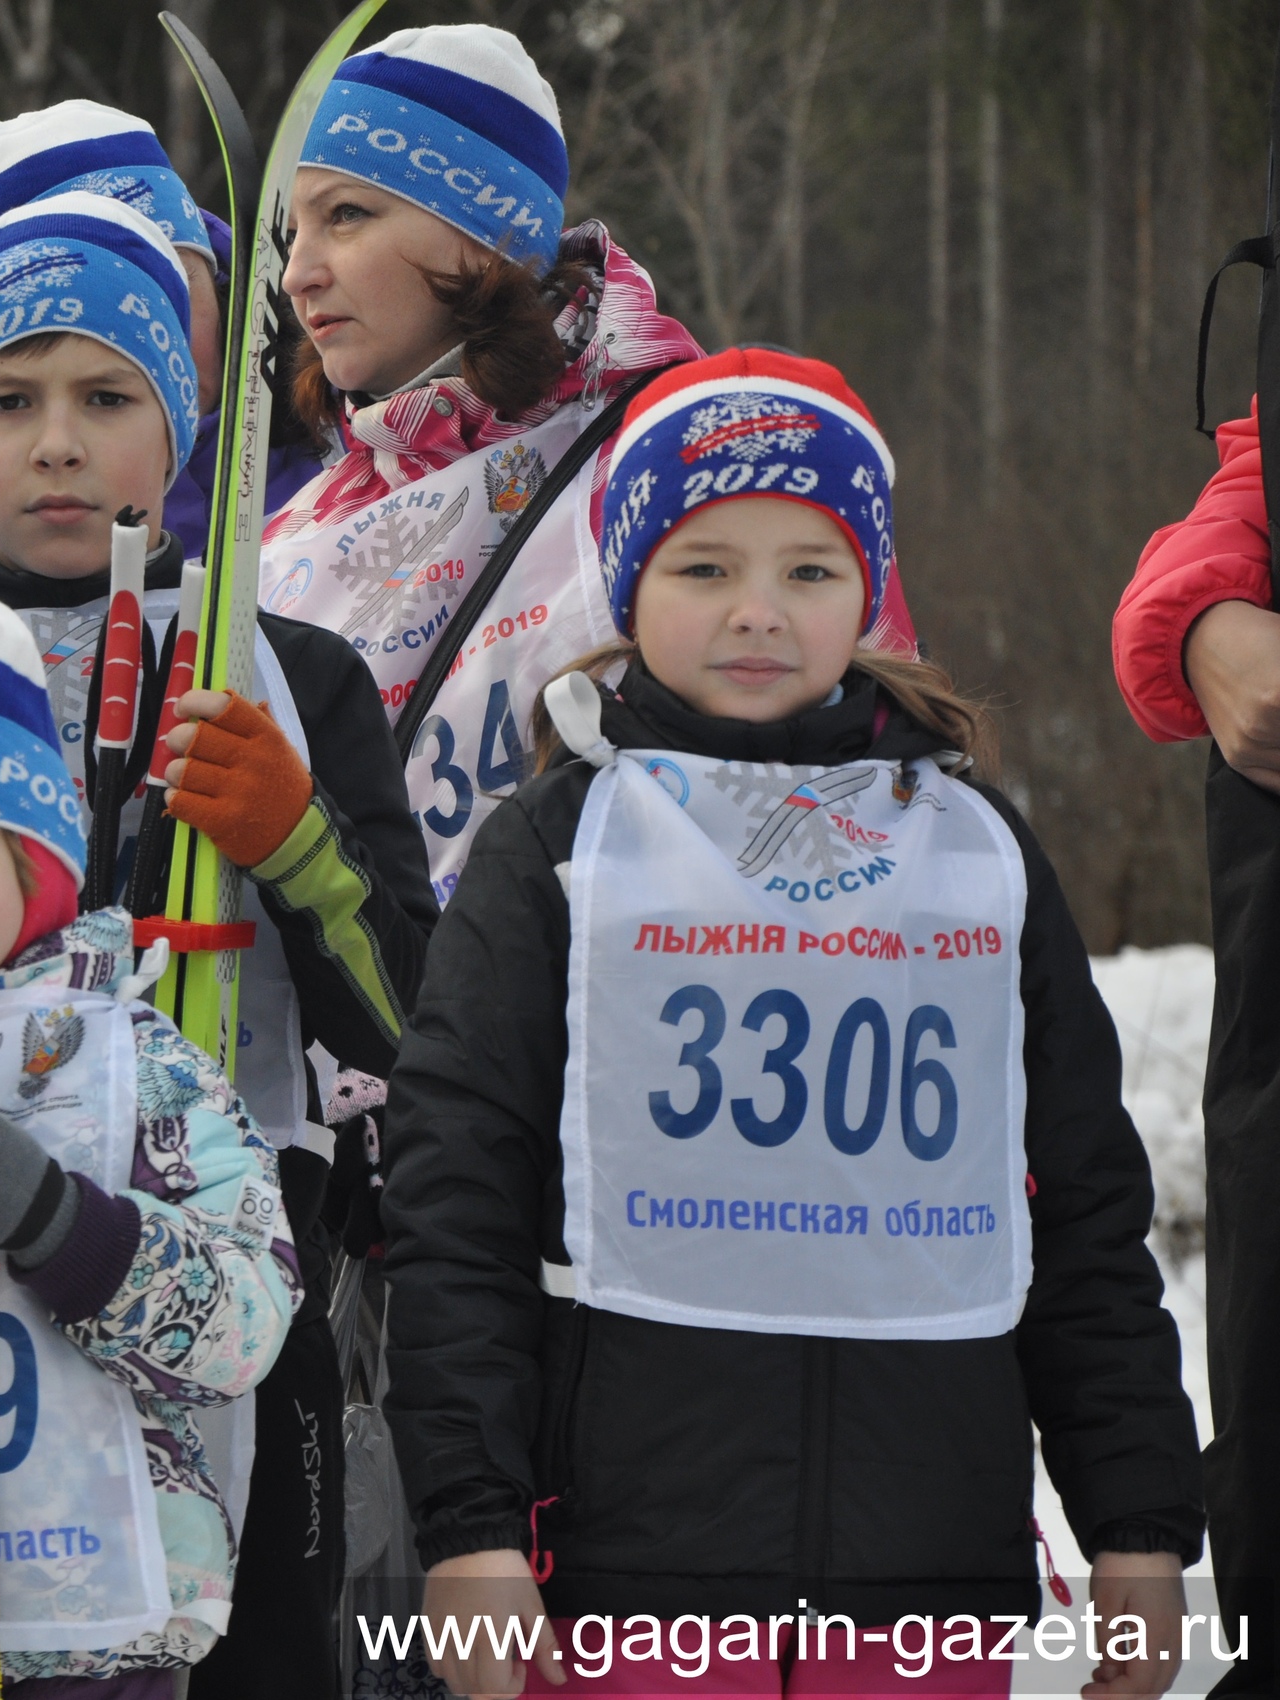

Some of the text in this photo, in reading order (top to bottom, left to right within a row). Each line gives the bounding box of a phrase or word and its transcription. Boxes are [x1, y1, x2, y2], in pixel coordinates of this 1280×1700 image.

[327, 113, 543, 237] РОССИИ
[683, 463, 819, 509] 2019
[336, 490, 446, 556] ЛЫЖНЯ
[412, 558, 465, 590] 2019
[351, 604, 450, 657] РОССИИ
[482, 604, 549, 648] 2019
[764, 856, 897, 903] РОССИИ
[634, 923, 786, 957] ЛЫЖНЯ
[798, 924, 907, 961] РОССИИ
[935, 926, 1002, 960] 2019
[648, 984, 959, 1162] 3306
[626, 1190, 996, 1237] Смоленская область
